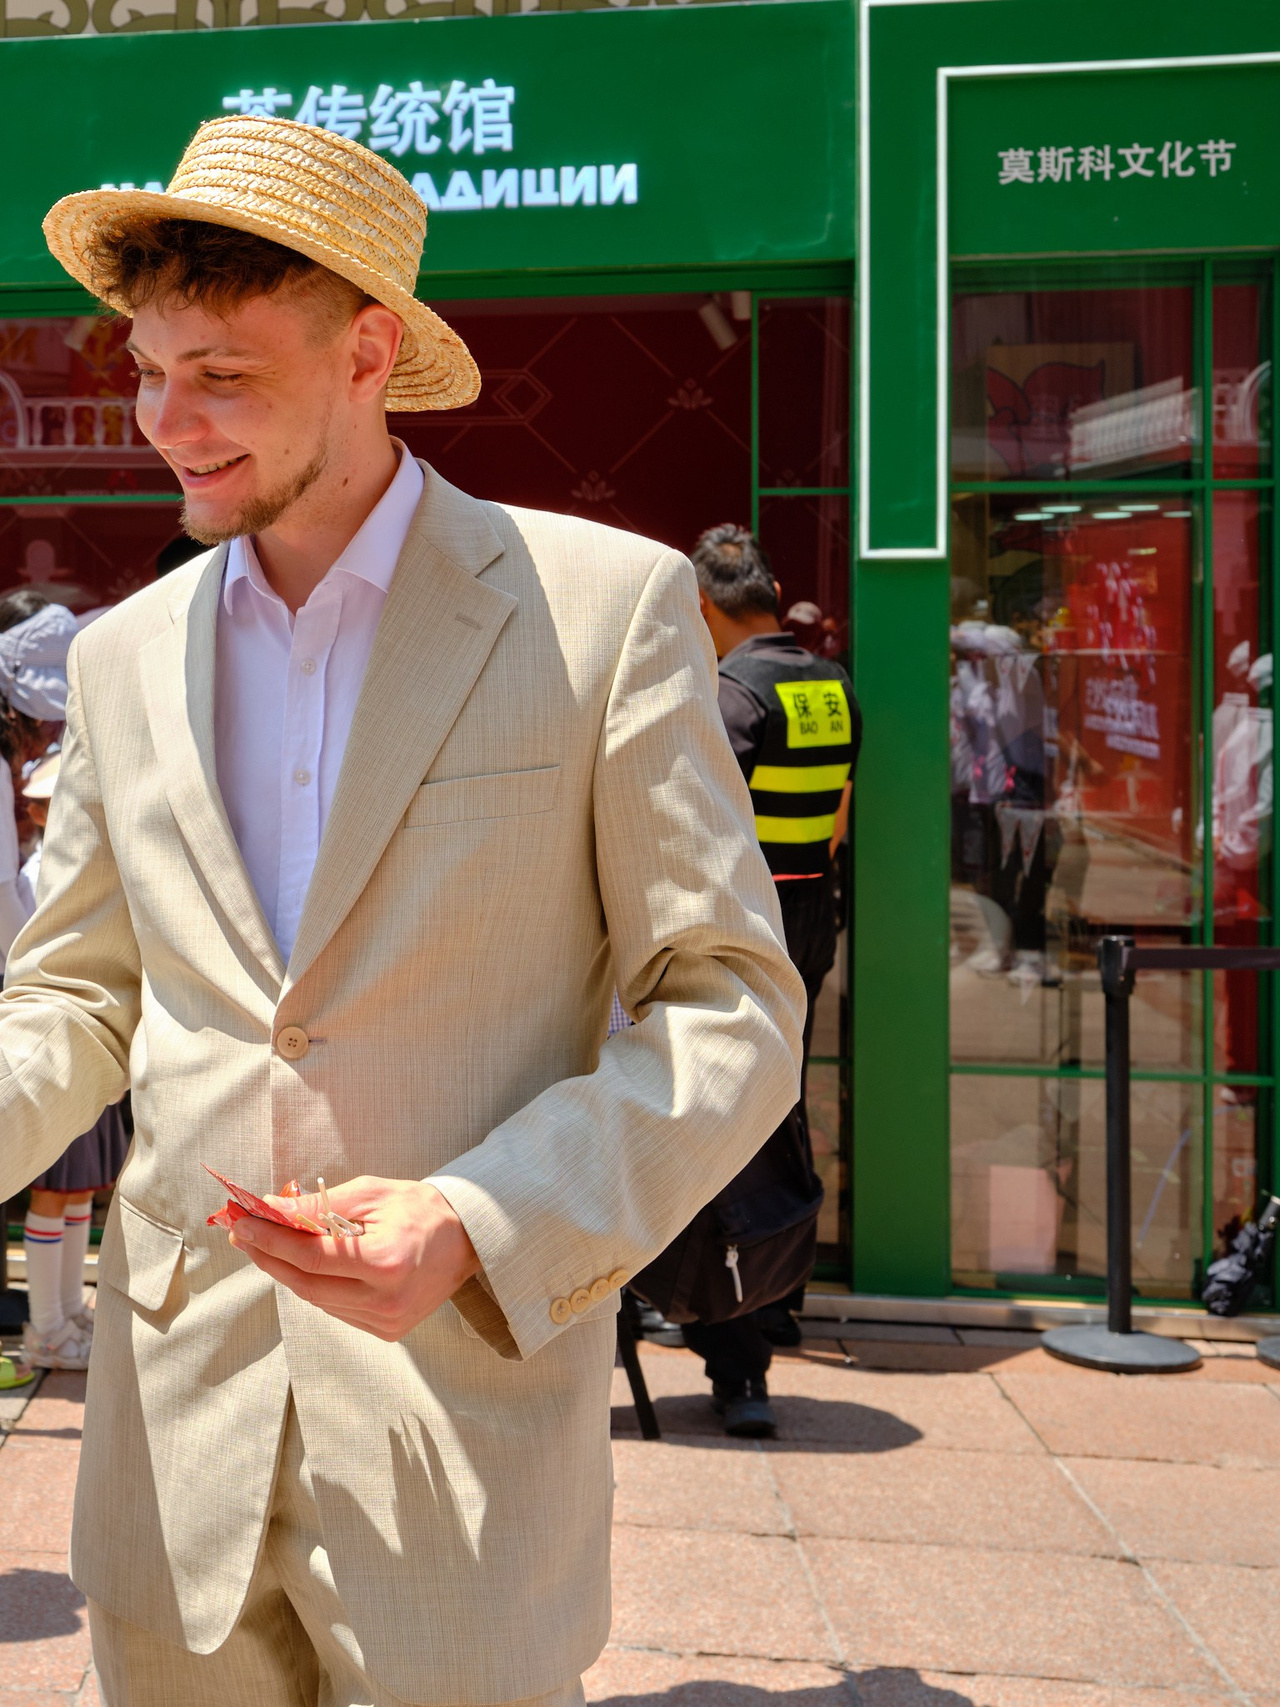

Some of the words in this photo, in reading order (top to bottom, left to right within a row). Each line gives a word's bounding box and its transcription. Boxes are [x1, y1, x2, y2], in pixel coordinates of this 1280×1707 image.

[997, 139, 1237, 185] 莫斯科文化节
[411, 163, 638, 211] АДИЦИИ
[792, 691, 842, 719] 保安
[800, 721, 818, 735] BAO
[830, 721, 844, 733] AN
